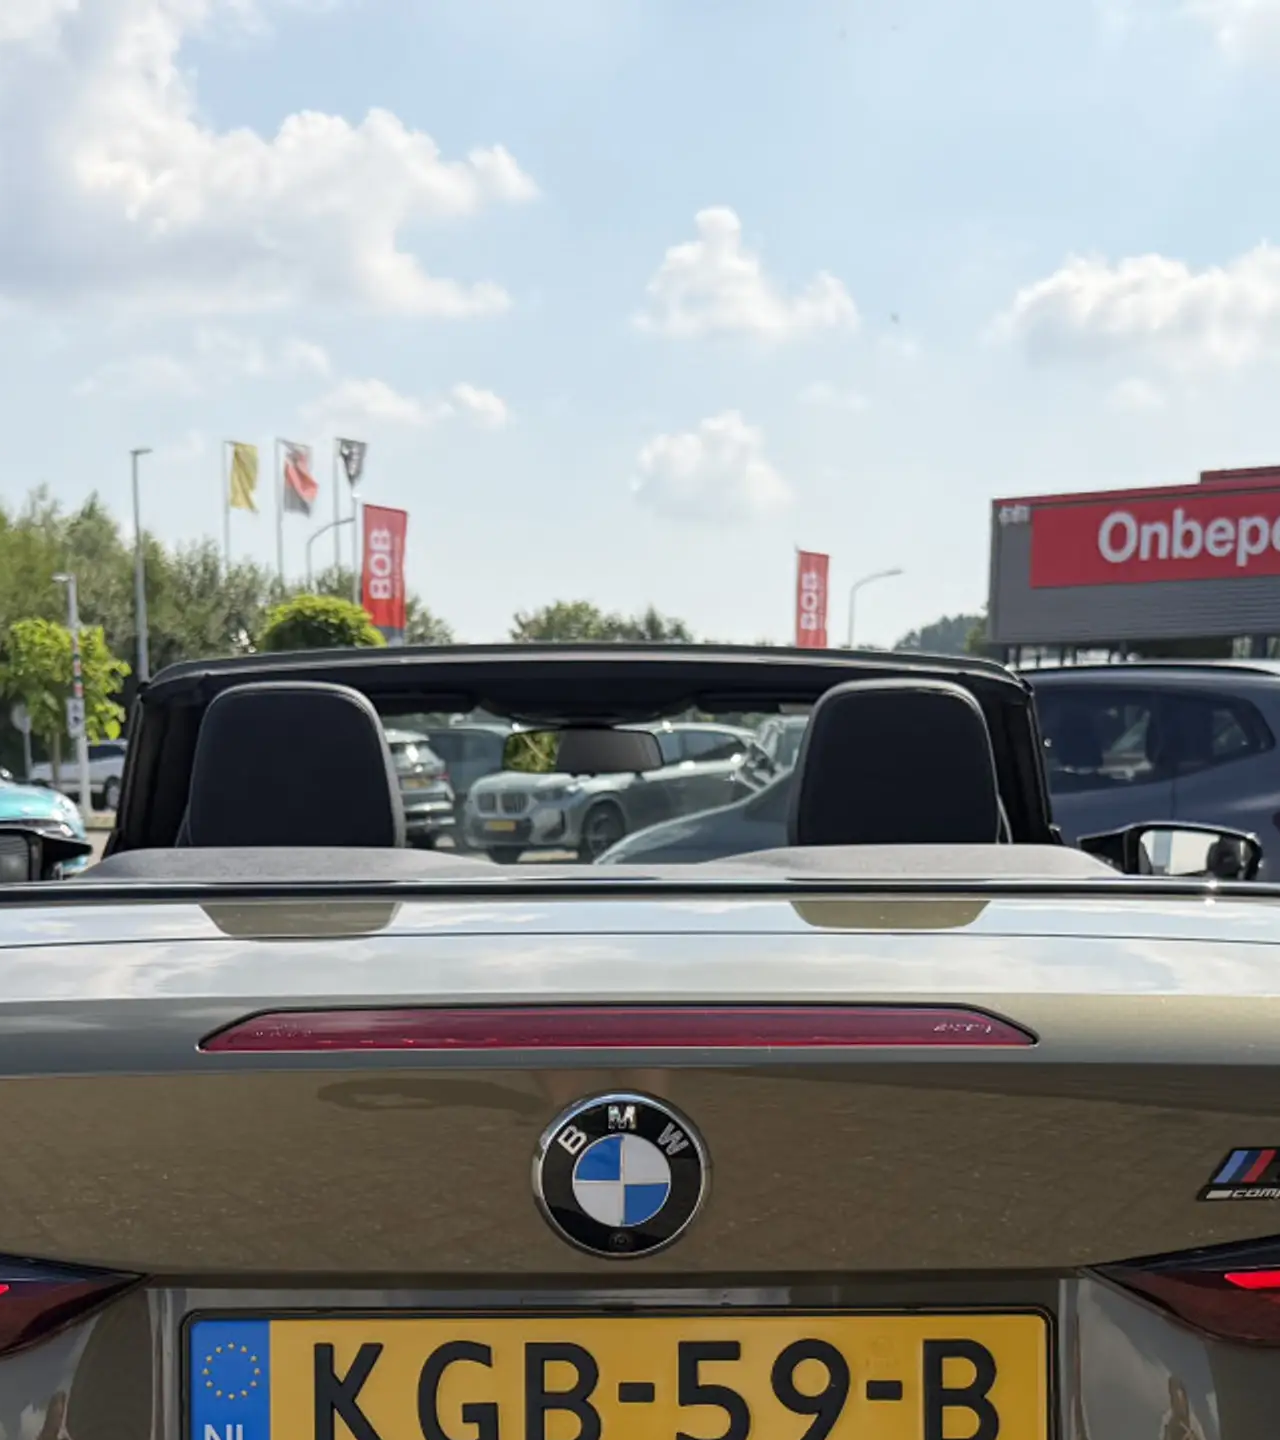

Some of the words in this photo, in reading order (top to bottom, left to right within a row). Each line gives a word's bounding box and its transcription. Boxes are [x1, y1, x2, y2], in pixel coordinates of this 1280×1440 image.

[370, 528, 392, 600] BOB
[801, 572, 818, 630] BOB
[557, 1105, 689, 1155] BMW
